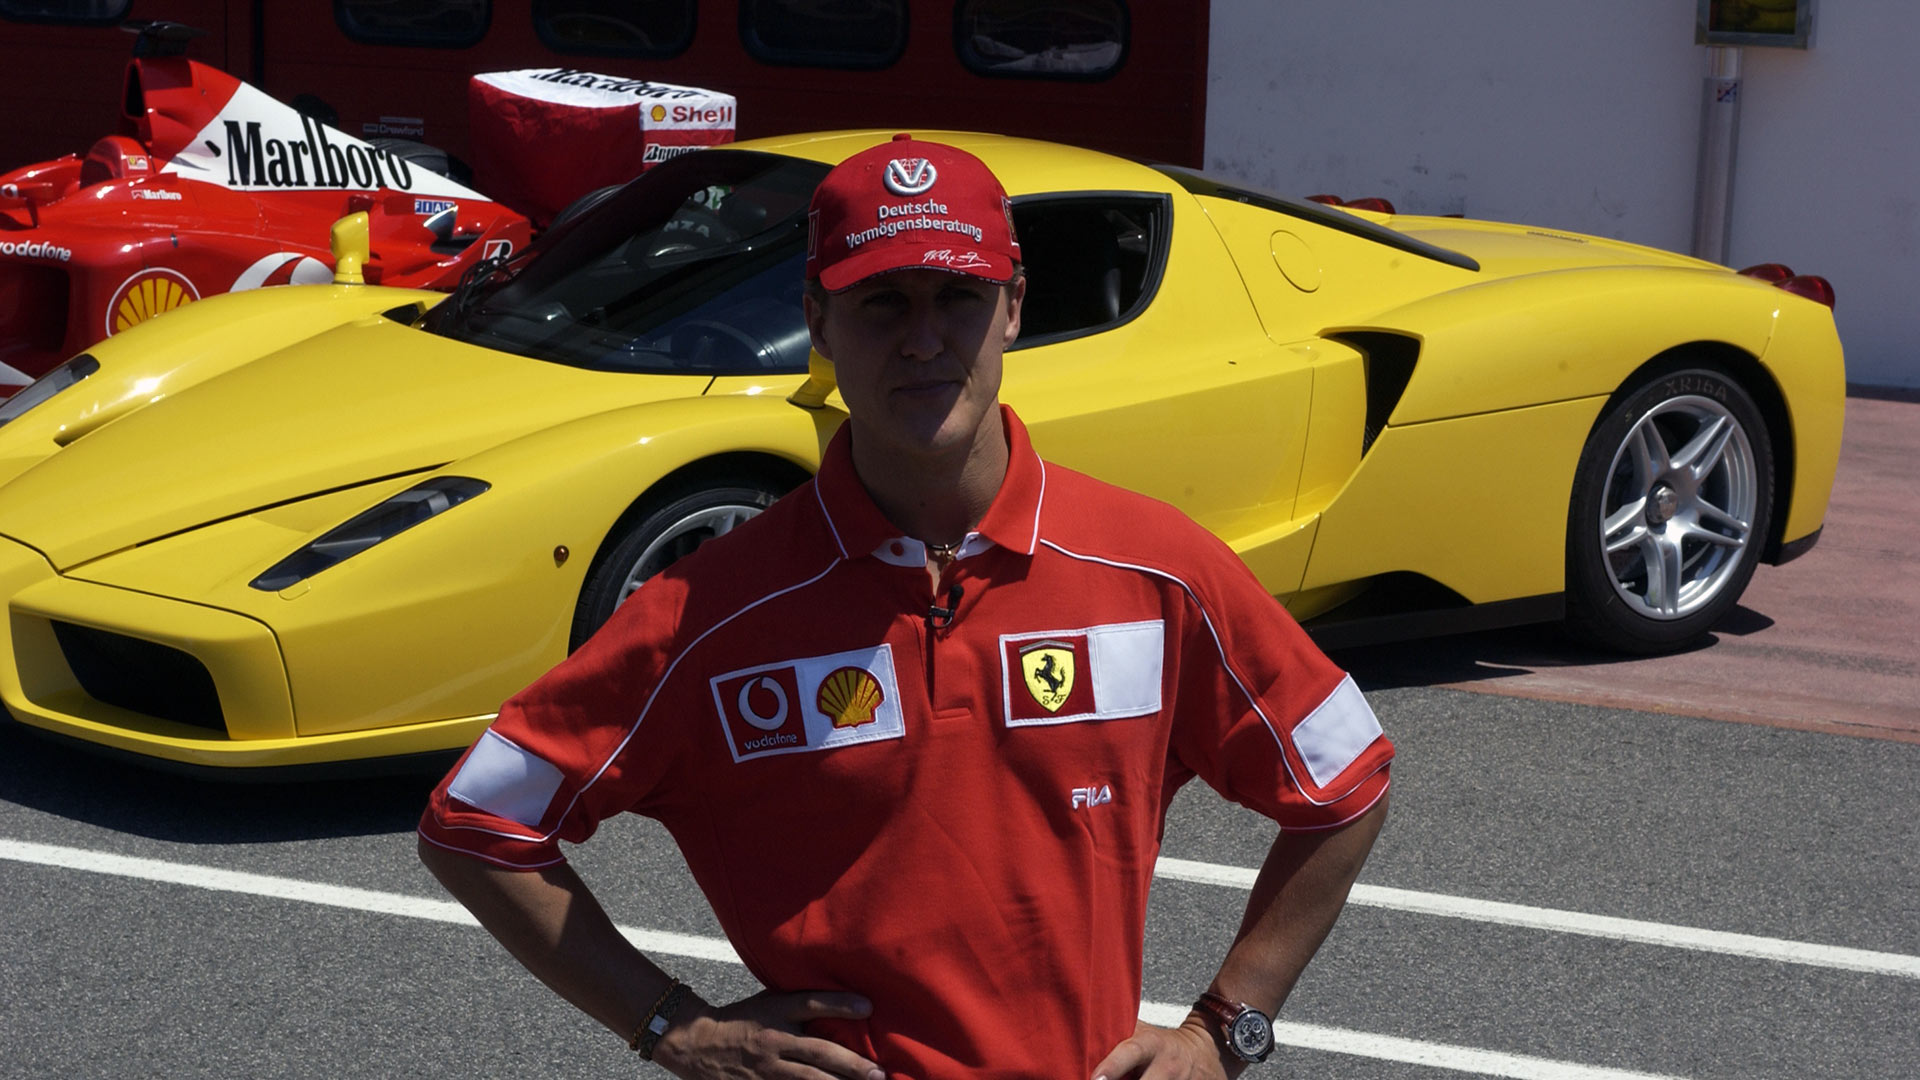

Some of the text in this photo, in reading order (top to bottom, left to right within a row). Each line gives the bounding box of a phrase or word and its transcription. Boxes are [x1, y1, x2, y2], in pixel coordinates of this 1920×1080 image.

[672, 105, 732, 122] Shell
[223, 114, 412, 190] Marlboro
[143, 189, 182, 200] Marlboro
[878, 199, 949, 219] Deutsche
[846, 215, 984, 248] Vermögensberatung
[744, 732, 799, 751] vodafone
[1071, 784, 1112, 810] FILA
